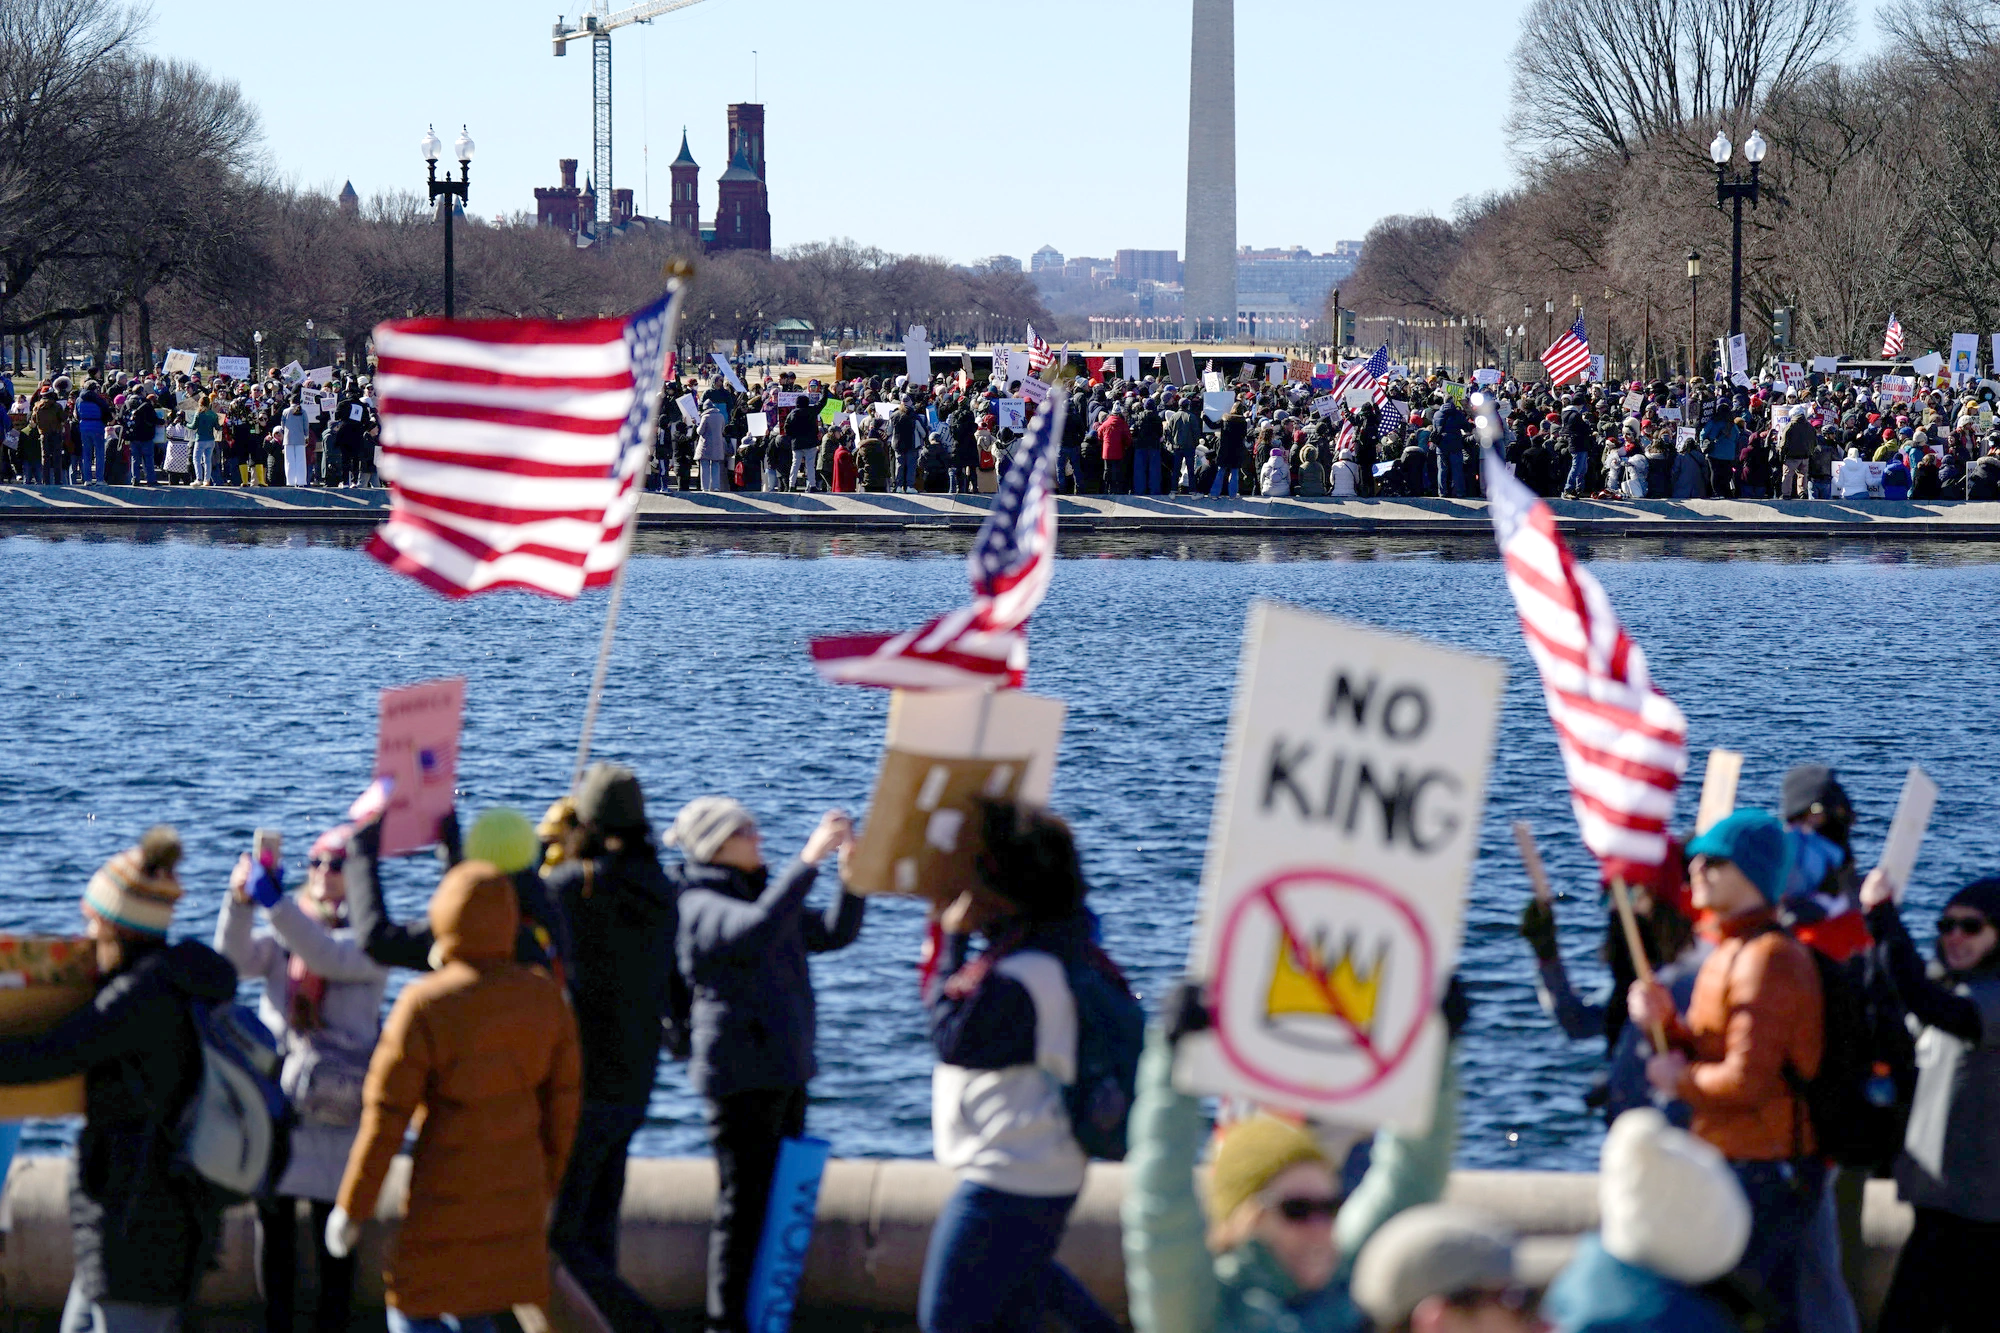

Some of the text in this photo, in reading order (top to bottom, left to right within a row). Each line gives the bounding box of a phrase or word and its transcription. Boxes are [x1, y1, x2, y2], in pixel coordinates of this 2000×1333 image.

[994, 349, 1009, 357] WE
[1292, 360, 1314, 371] DELETE
[1290, 369, 1311, 382] DOGE
[1883, 375, 1901, 384] SAVE
[1326, 670, 1431, 743] NO
[1261, 737, 1465, 857] KING
